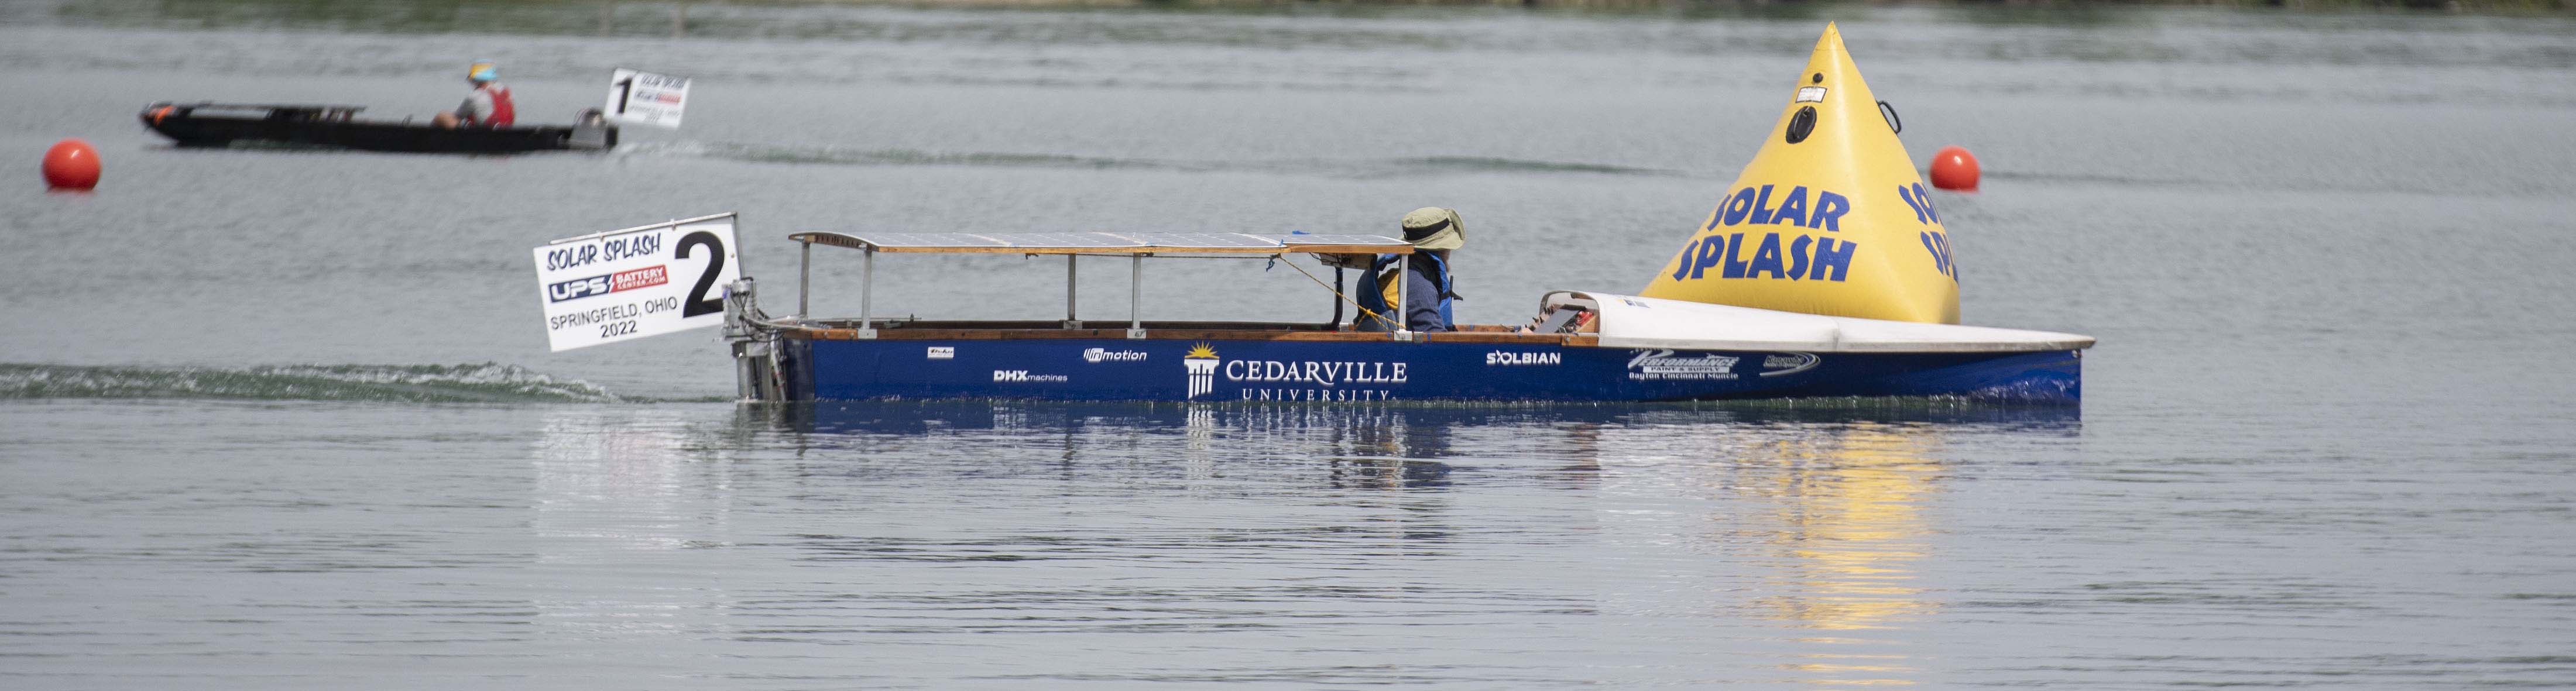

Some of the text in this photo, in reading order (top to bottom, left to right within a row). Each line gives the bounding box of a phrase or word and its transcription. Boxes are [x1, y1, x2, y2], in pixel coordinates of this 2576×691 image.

[616, 77, 633, 114] 1
[1707, 184, 1850, 232] SOLAR
[547, 232, 661, 271] SOLAR SPLASH
[1672, 232, 1857, 282] SPLASH
[615, 266, 664, 283] BATTERY
[674, 231, 725, 319] 2
[551, 277, 608, 300] UPS
[551, 296, 678, 330] SPRINGFIELD, OHIO
[600, 319, 638, 338] 2022
[1486, 349, 1561, 366] SOLBIAN
[1628, 348, 1740, 369] PERFORMANCE
[1226, 360, 1407, 386] CEDARVILLE
[1629, 372, 1739, 381] Dayton Cincinnati Muncie
[1242, 389, 1391, 401] UNIVERSITY
